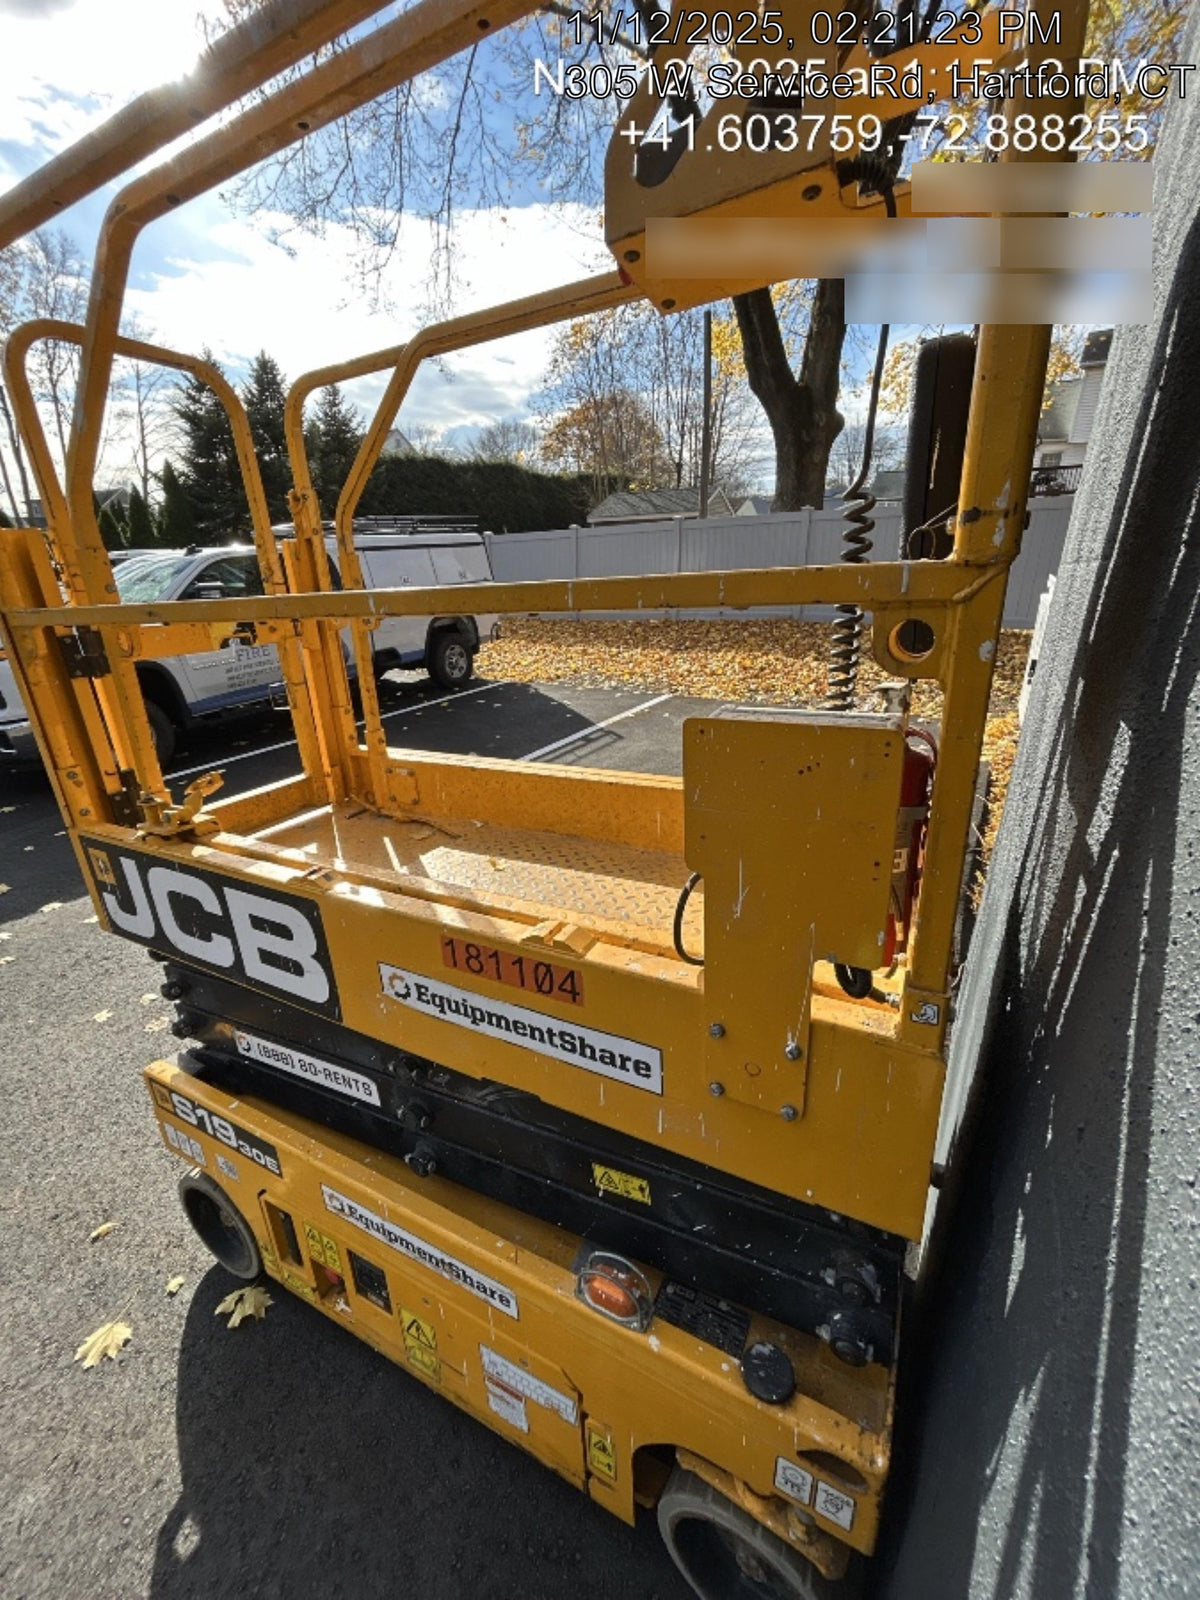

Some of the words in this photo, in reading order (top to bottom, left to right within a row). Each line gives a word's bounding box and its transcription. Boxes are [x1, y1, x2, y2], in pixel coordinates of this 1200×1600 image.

[103, 857, 330, 1004] JCB
[444, 938, 581, 1004] 181104
[256, 1042, 295, 1069] (888)
[298, 1059, 373, 1097] 80-RENTS
[413, 982, 653, 1080] EquipmentShare
[346, 1202, 512, 1309] EquipmentShare
